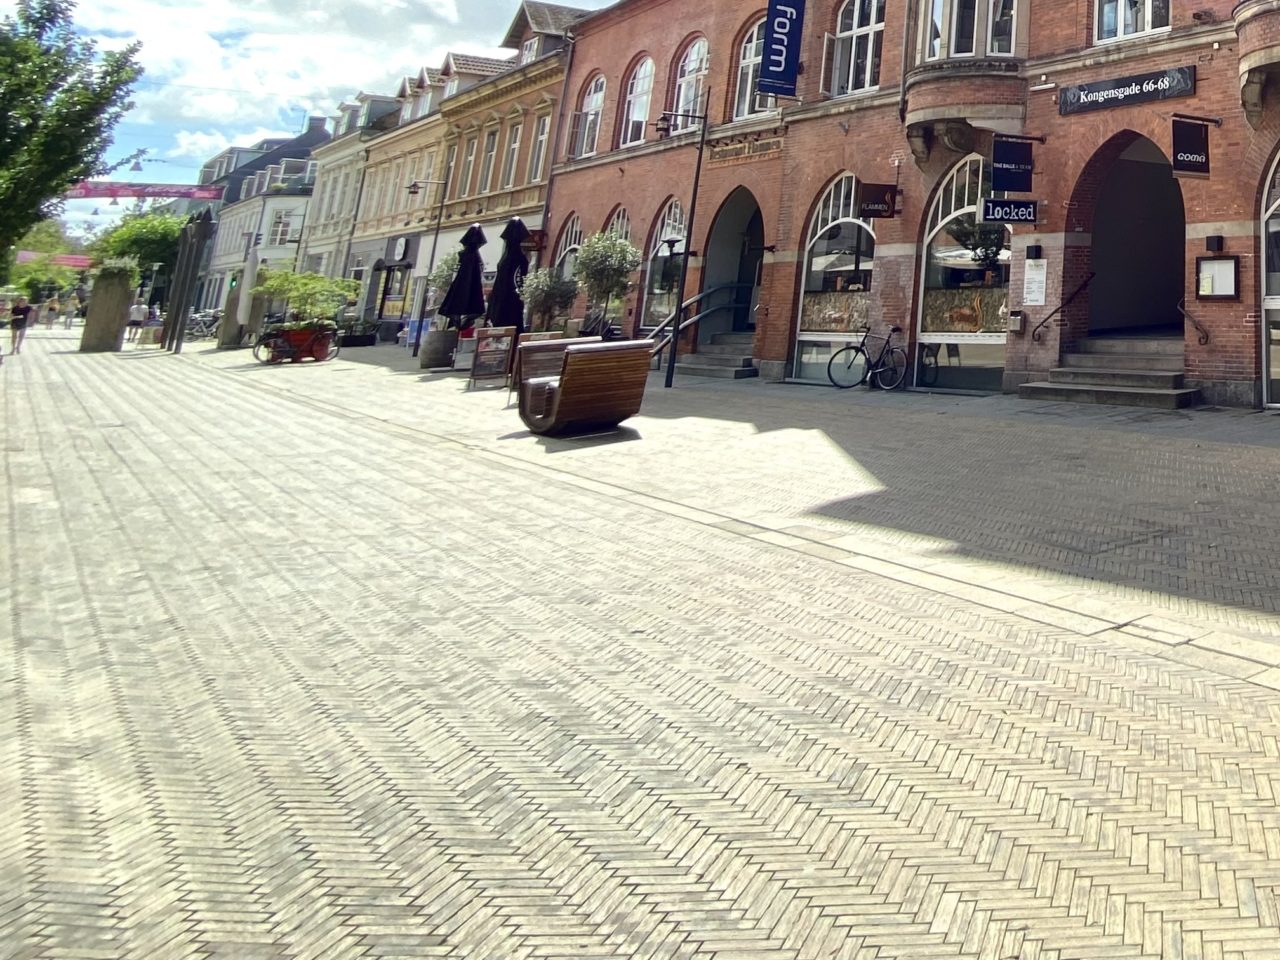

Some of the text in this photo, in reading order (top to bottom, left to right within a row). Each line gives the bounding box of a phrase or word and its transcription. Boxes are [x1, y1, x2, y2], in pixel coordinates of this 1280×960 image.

[769, 5, 796, 72] form
[1080, 76, 1170, 103] Kongensgade 66-68
[986, 203, 1035, 220] locked
